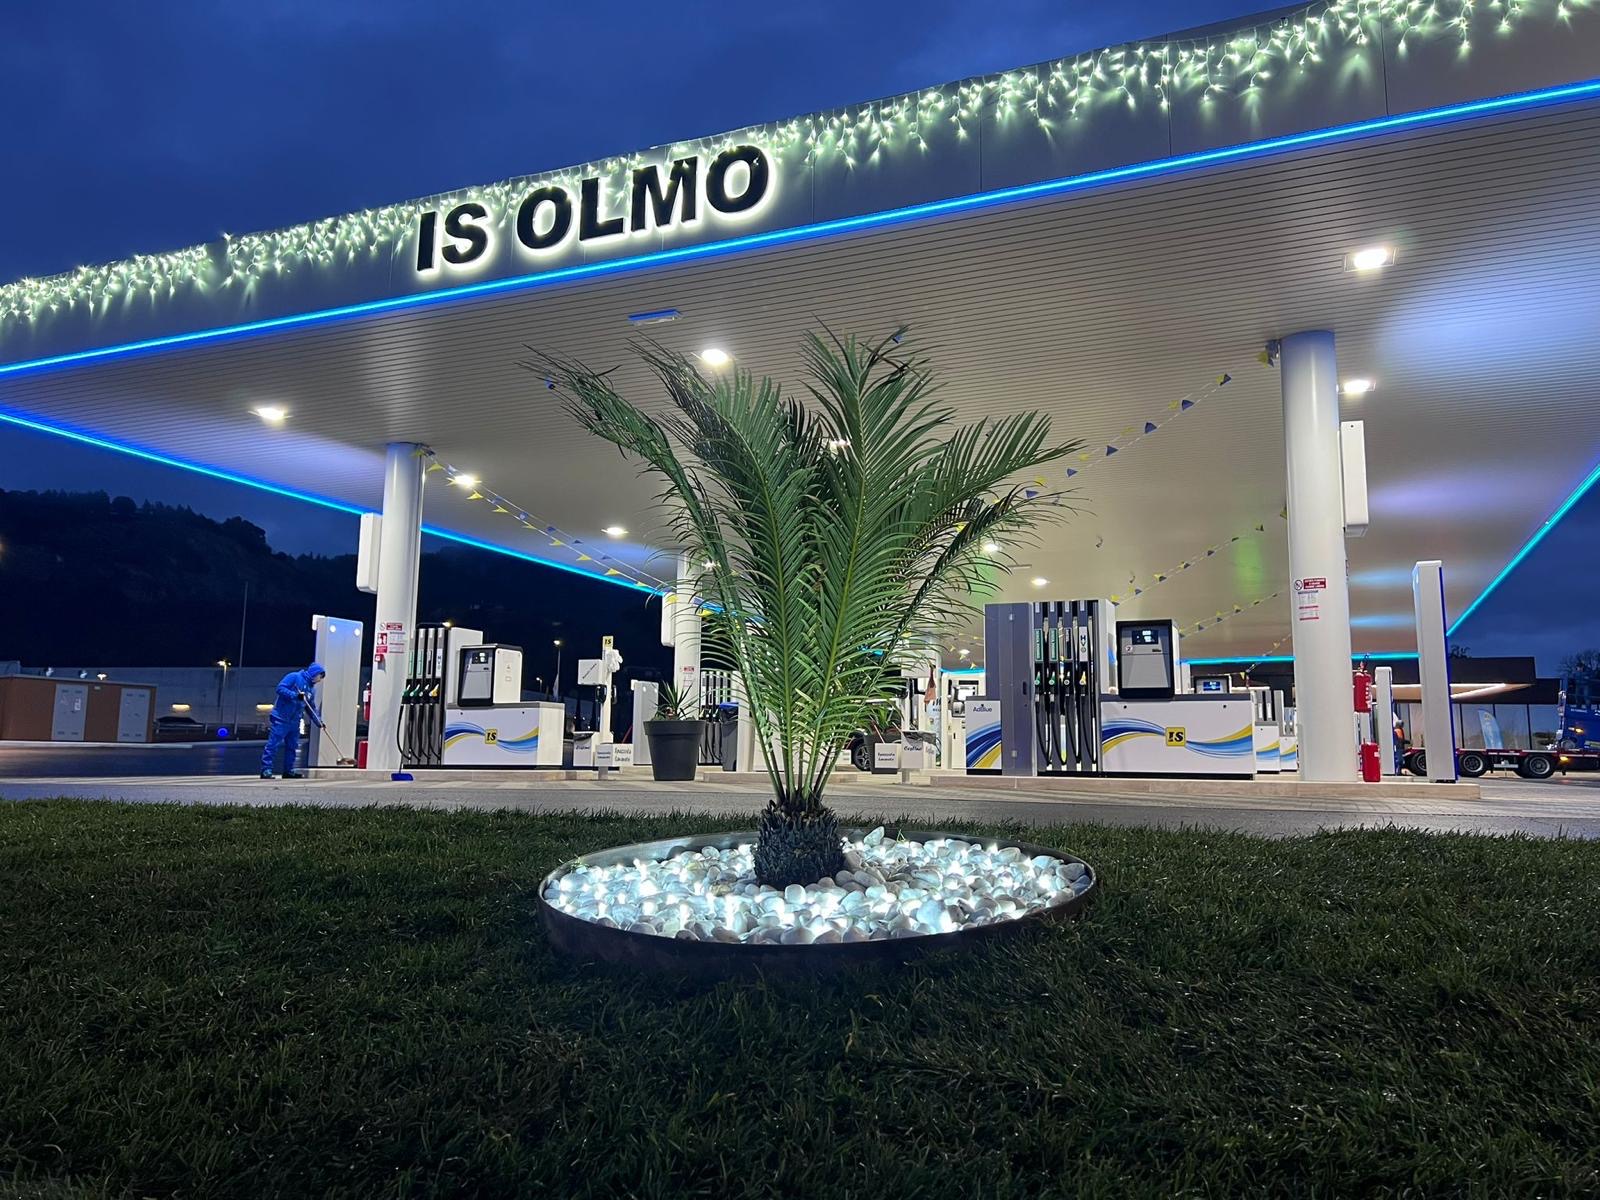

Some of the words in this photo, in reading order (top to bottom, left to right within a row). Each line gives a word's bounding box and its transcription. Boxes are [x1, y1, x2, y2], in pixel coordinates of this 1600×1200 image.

[416, 202, 489, 272] IS
[516, 145, 769, 250] OLMO
[487, 732, 497, 741] IS
[1168, 731, 1184, 742] IS
